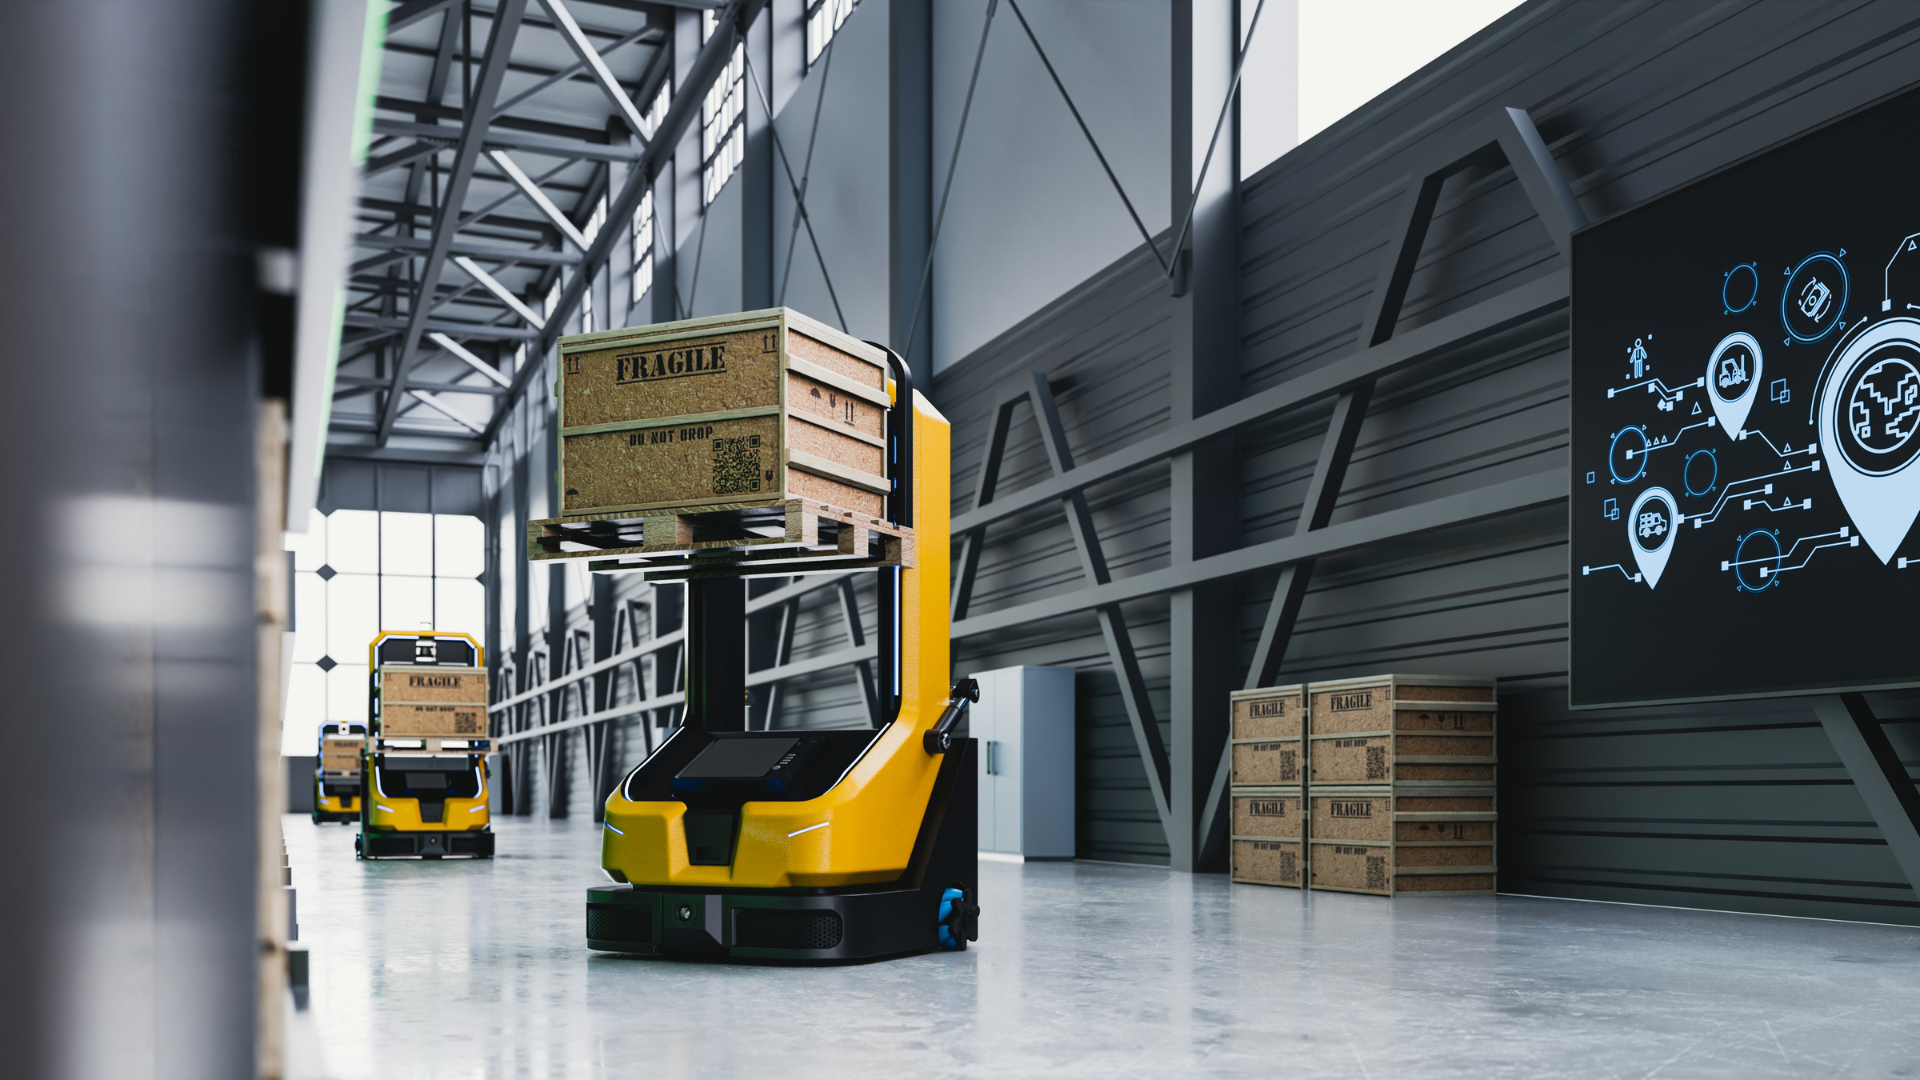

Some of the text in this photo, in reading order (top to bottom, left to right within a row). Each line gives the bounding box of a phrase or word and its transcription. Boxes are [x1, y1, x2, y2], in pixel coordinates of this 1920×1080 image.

[616, 346, 725, 381] FRAGILE
[630, 426, 713, 446] DO NOT DROP
[409, 676, 461, 688] FRAGILE
[1249, 701, 1285, 717] FRAGILE
[1331, 694, 1372, 710] FRAGILE
[1249, 802, 1285, 815] FRAGILE
[1331, 802, 1372, 816] FRAGILE
